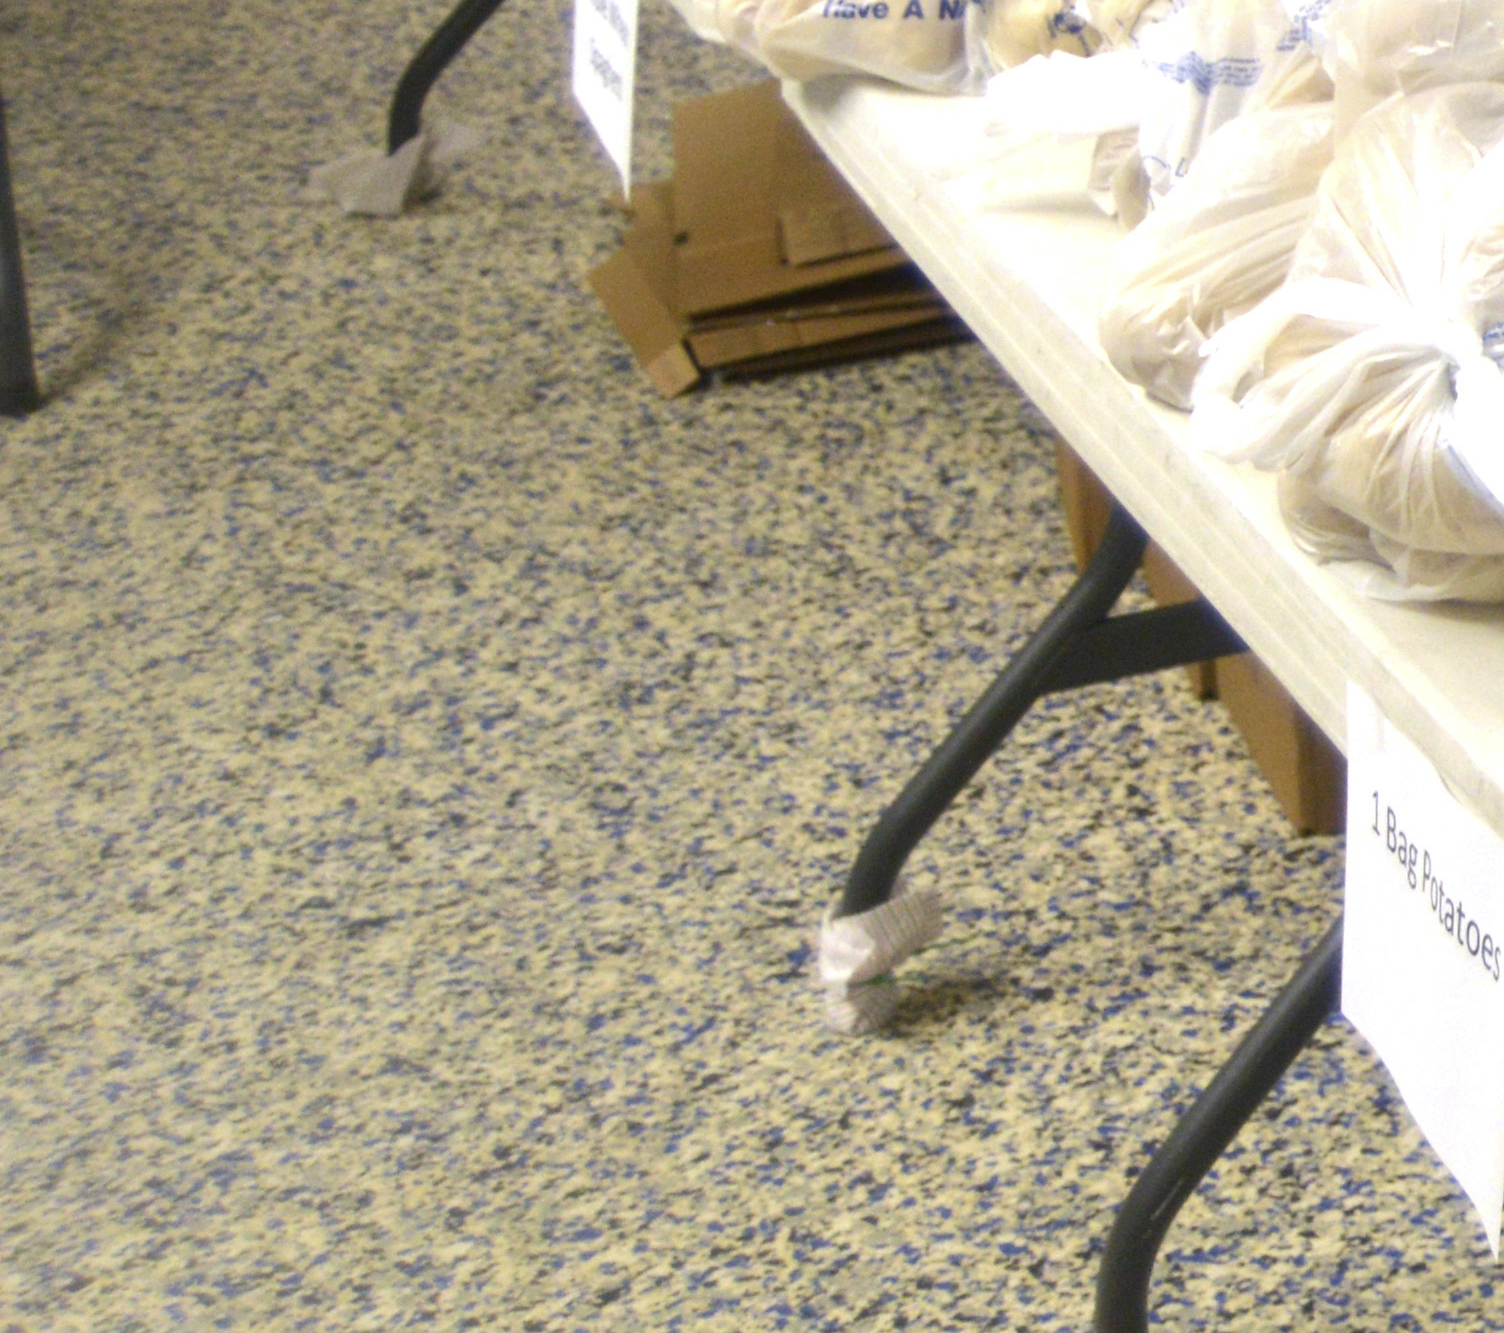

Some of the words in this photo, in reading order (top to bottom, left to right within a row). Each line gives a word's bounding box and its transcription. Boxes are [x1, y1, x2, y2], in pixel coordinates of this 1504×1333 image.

[1371, 789, 1381, 838] 1
[1386, 806, 1418, 890] Bag
[1423, 849, 1502, 983] Potatoes
